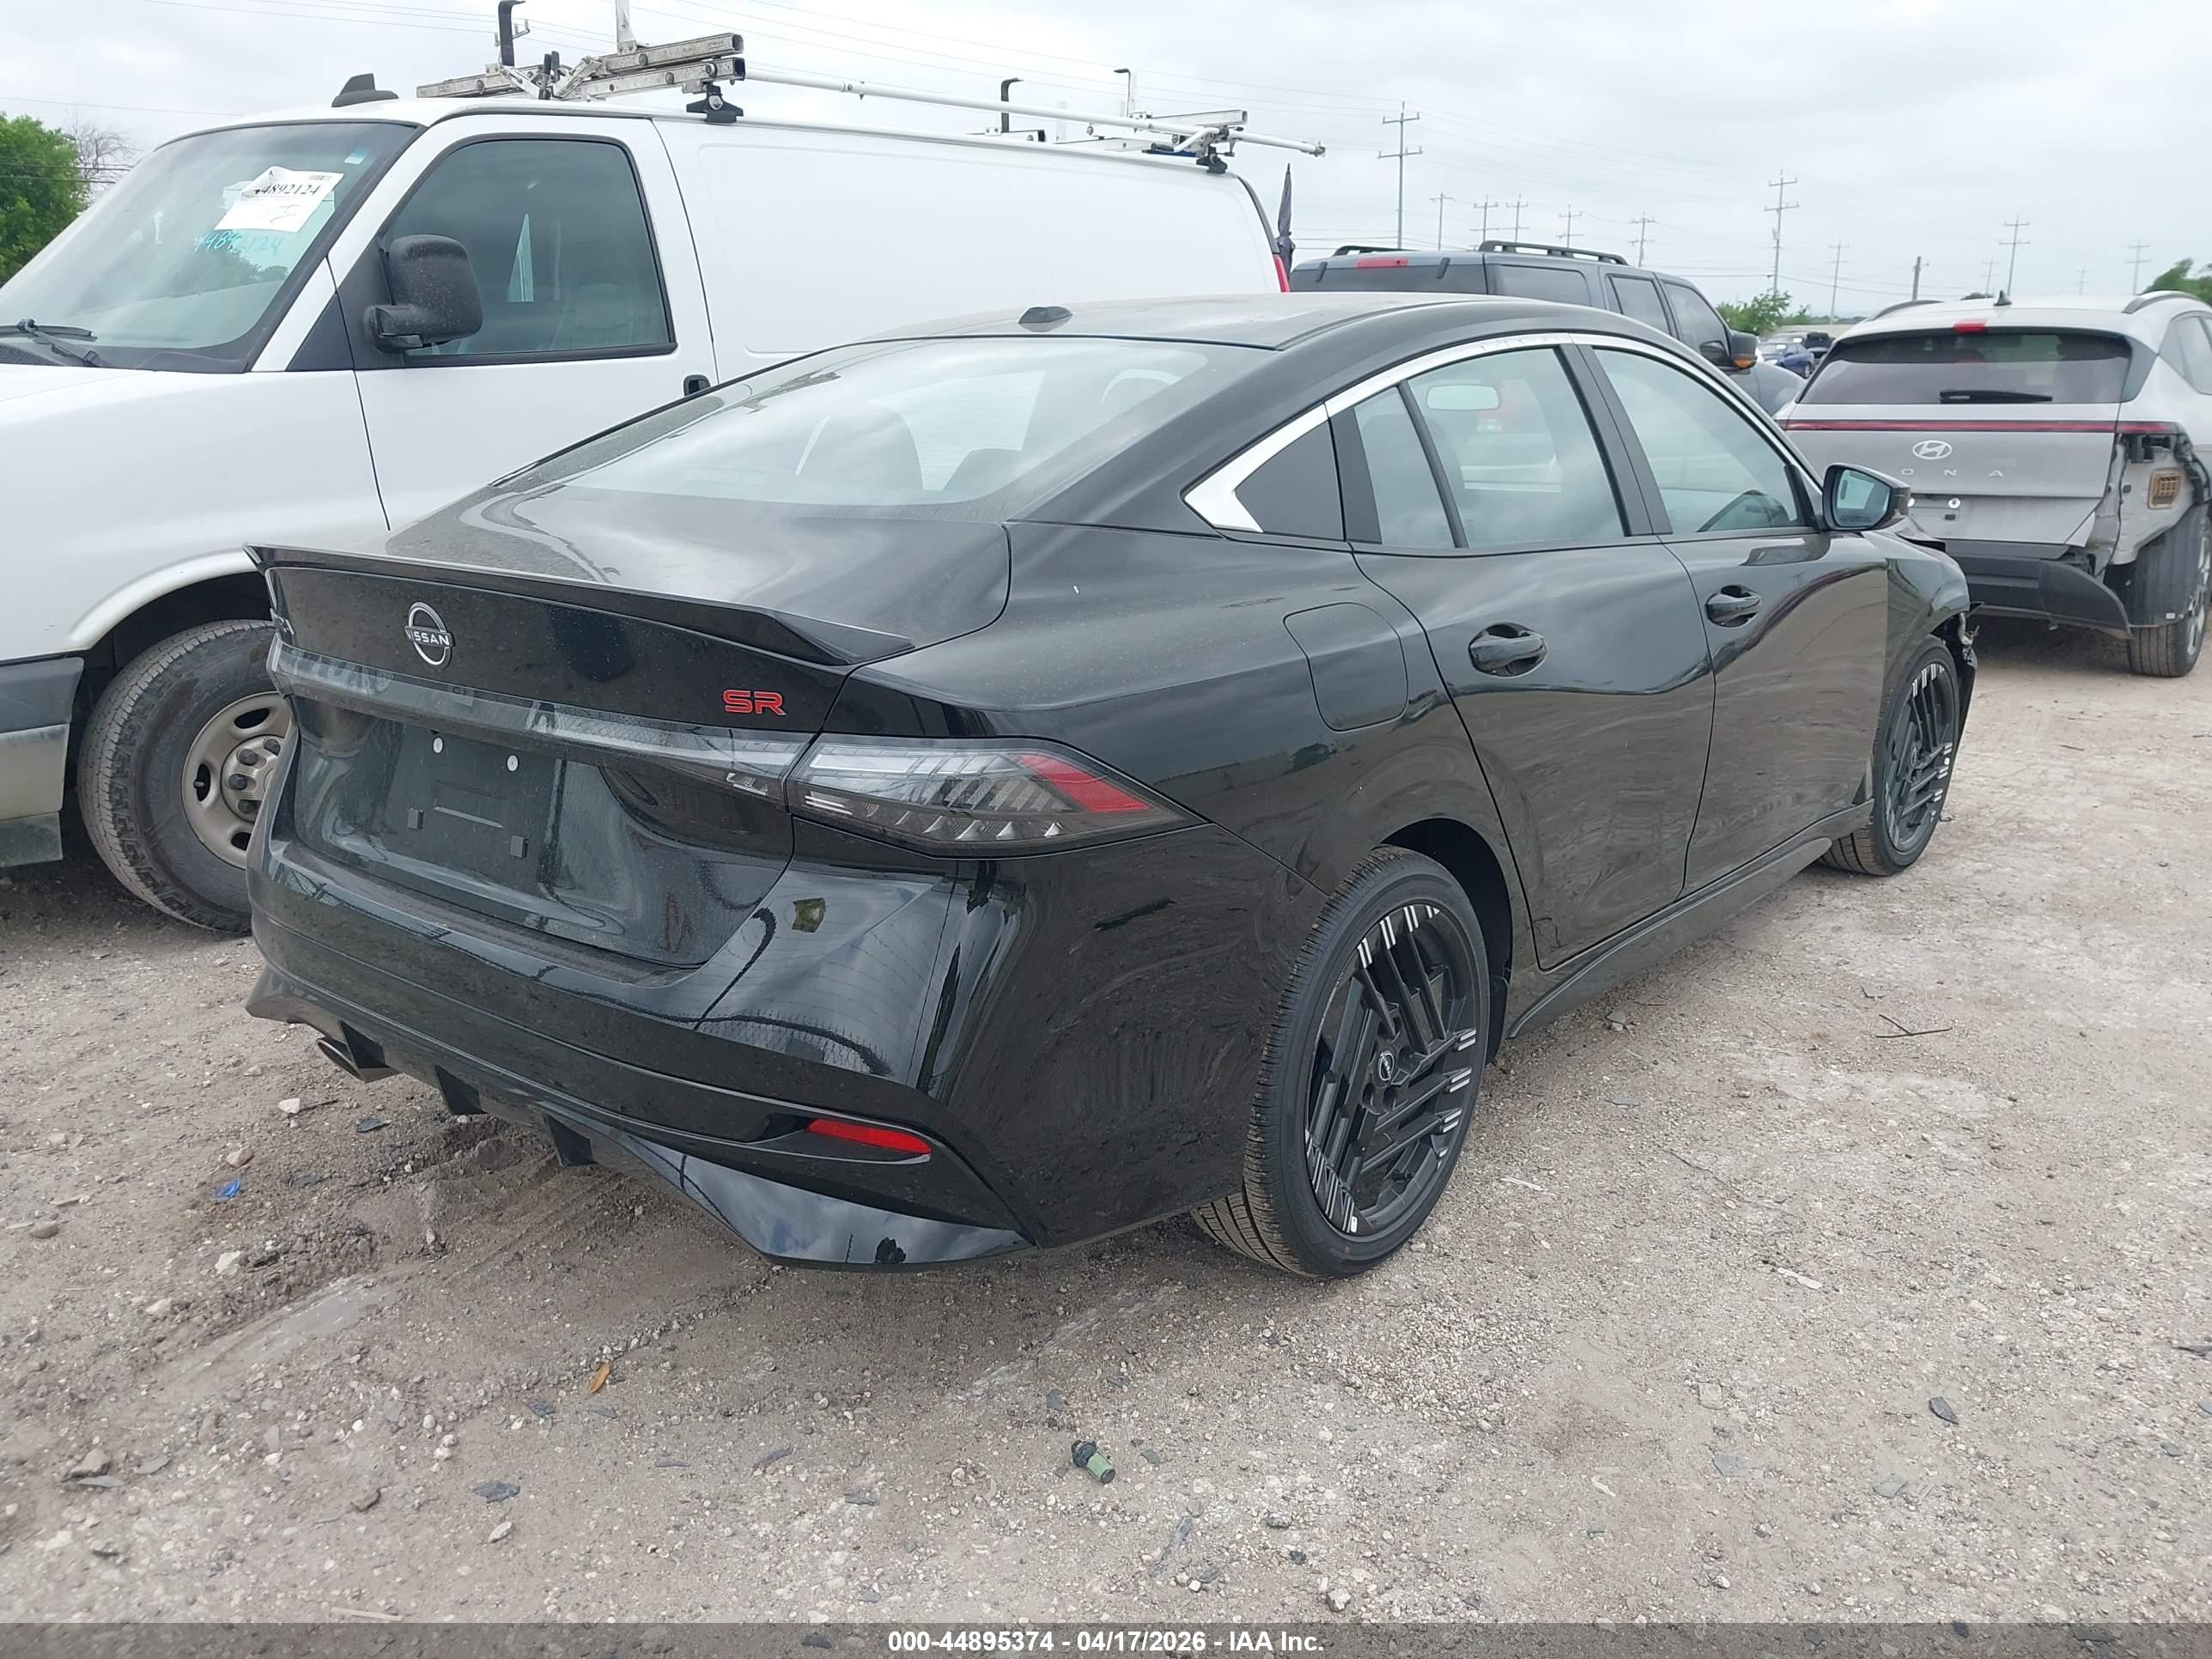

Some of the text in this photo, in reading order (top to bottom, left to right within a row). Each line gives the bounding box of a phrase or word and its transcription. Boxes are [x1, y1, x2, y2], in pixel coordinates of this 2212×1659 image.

[1900, 468, 2004, 477] ONA
[404, 628, 451, 646] NISSAN
[723, 690, 787, 716] SR
